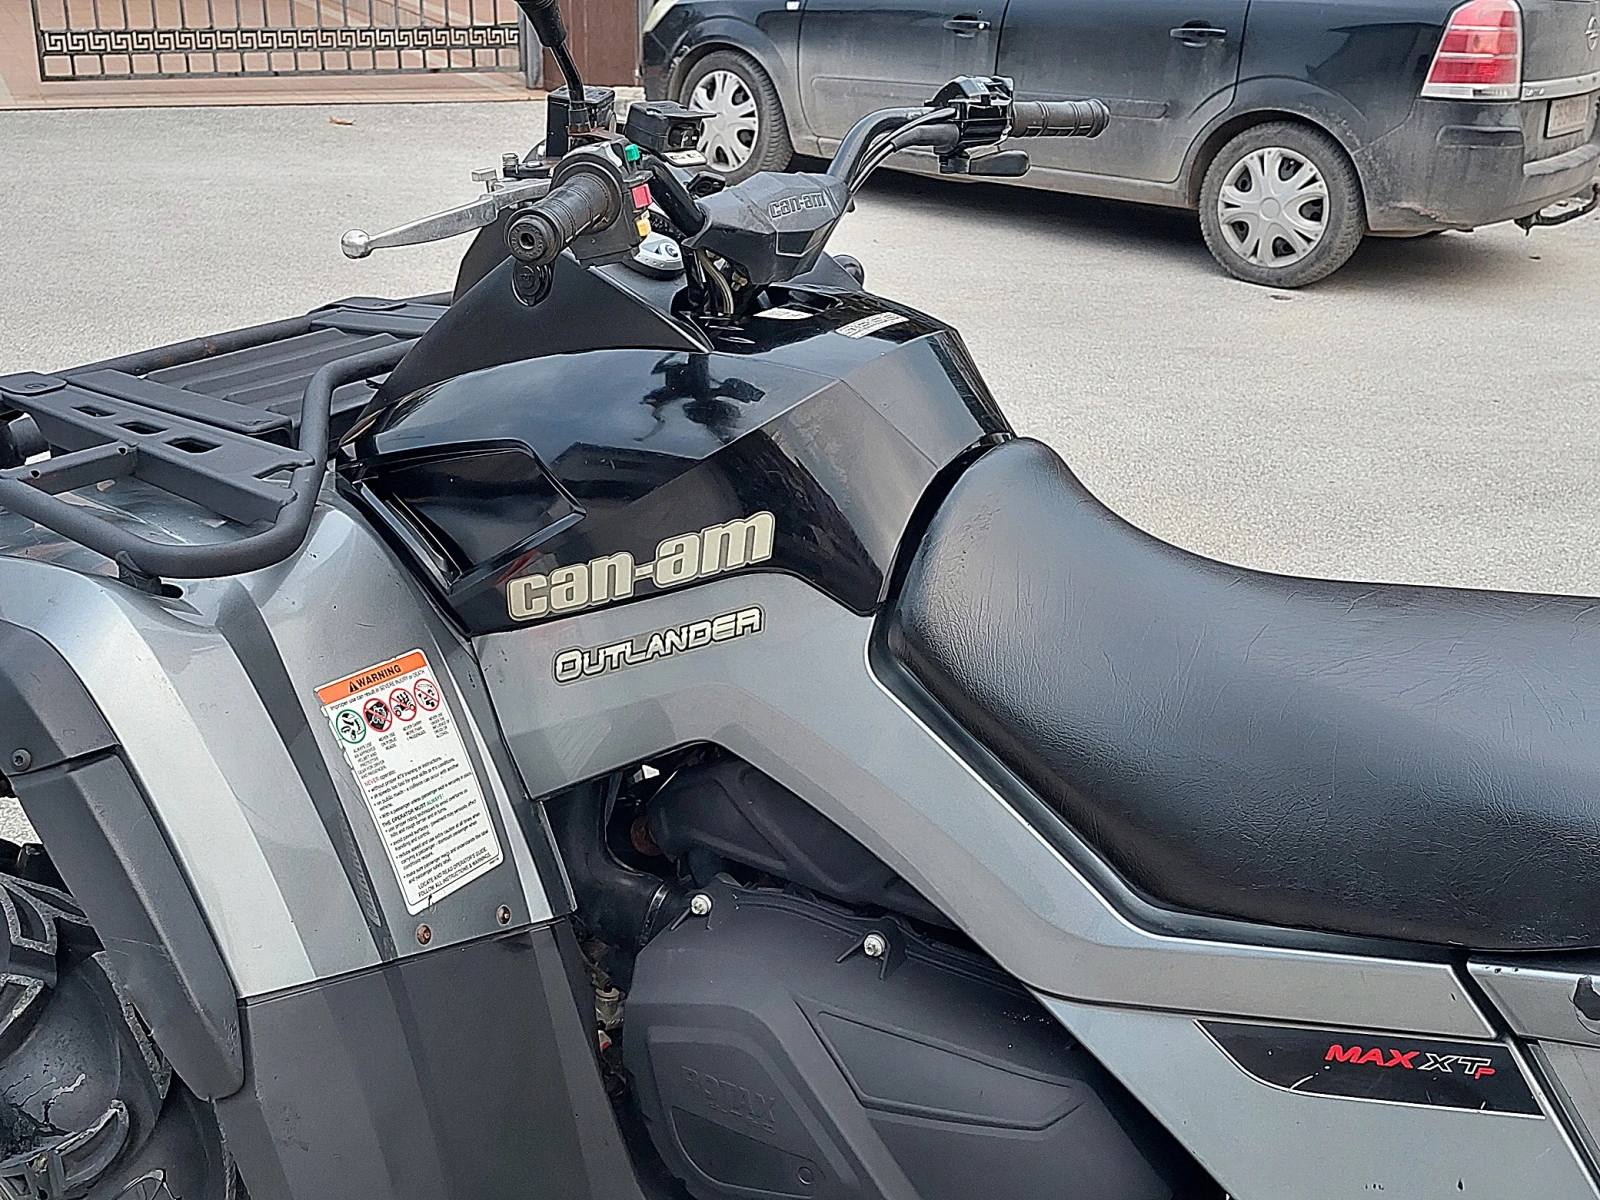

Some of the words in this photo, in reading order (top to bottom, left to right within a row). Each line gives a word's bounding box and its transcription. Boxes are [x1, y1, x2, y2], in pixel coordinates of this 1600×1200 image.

[769, 192, 826, 219] can-am
[508, 511, 775, 620] can-am
[555, 606, 765, 682] OUTLANDER
[356, 665, 401, 687] WARNING
[1325, 1044, 1420, 1069] MAX
